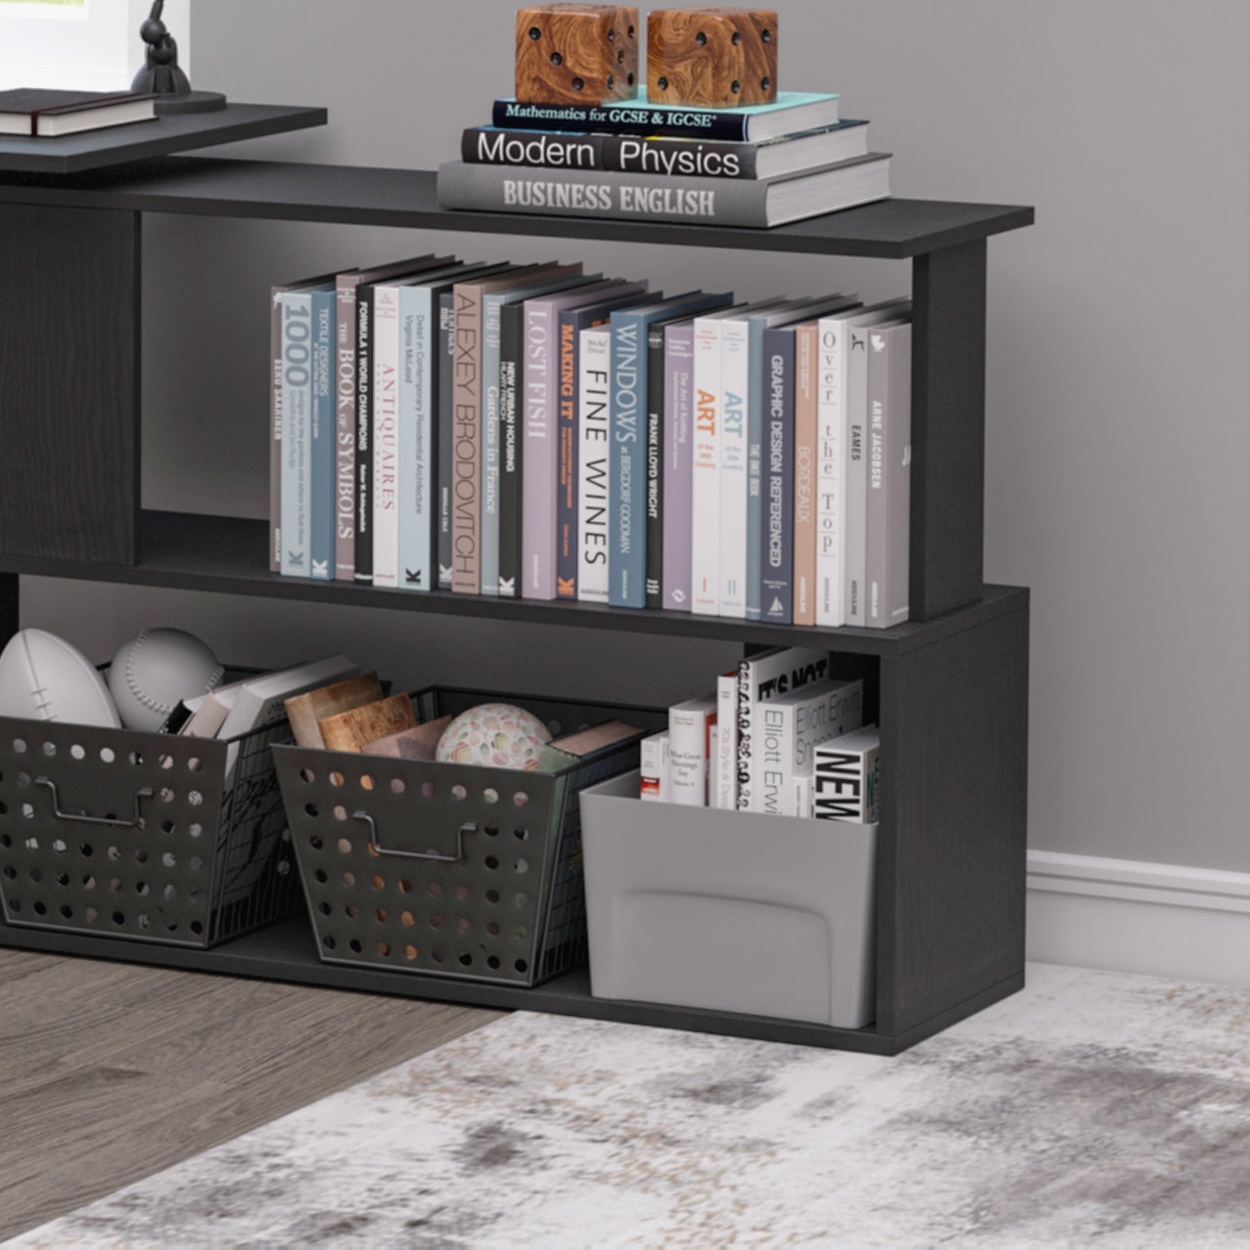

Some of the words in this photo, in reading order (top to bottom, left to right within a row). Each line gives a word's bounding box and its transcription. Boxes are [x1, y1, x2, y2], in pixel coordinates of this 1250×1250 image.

[506, 103, 586, 122] Mathematics
[589, 107, 607, 122] for
[609, 109, 648, 124] GCSE
[652, 111, 664, 125] &
[477, 132, 595, 166] Modern
[618, 141, 740, 176] Physics
[503, 180, 612, 210] BUSINESS
[619, 187, 715, 216] ENGLISH
[285, 304, 309, 387] 1000
[319, 308, 328, 343] TEXTILE
[339, 323, 347, 343] THE
[359, 302, 368, 348] FORMULA
[404, 315, 414, 346] Virginia
[416, 316, 424, 339] Detail
[456, 294, 476, 396] ALEXEY
[528, 310, 547, 376] LOST
[319, 346, 328, 396] DESIGNERS
[339, 349, 354, 408] BOOK
[359, 358, 368, 392] WORLD
[405, 349, 414, 383] McLeod
[414, 352, 424, 411] Contemporary
[506, 362, 515, 385] NEW
[561, 324, 573, 396] MAKING
[615, 323, 637, 442] WINDOWS
[680, 372, 688, 385] The
[506, 388, 515, 423] URBAN
[586, 369, 607, 442] FINE
[680, 387, 688, 400] Art
[680, 403, 688, 411] of
[770, 355, 783, 417] GRAPHIC
[339, 414, 347, 428] OF
[358, 394, 368, 450] CHAMPIONS
[487, 386, 498, 445] Gardens
[528, 382, 547, 438] FISH
[561, 401, 573, 419] IT
[648, 414, 658, 445] FRANK
[678, 412, 688, 444] Knitting
[697, 389, 716, 436] ART
[724, 391, 743, 438] ART
[872, 401, 882, 429] ARNE
[379, 364, 395, 510] ANTIQUAIRES
[415, 414, 424, 461] Residential
[487, 448, 498, 461] in
[506, 425, 515, 471] HOUSING
[750, 444, 760, 458] THE
[770, 421, 783, 472] DESIGN
[851, 425, 861, 461] EAMES
[620, 455, 630, 503] BERGDORF
[648, 447, 658, 478] LLOYD
[797, 446, 810, 522] BORDEAUX
[871, 433, 882, 489] JACOBSEN
[338, 433, 354, 538] SYMBOLS
[415, 464, 424, 514] Architecture
[455, 405, 476, 573] BRODOVITCH
[487, 467, 497, 513] France
[648, 480, 658, 518] WRIGHT
[585, 459, 606, 566] WINES
[620, 505, 630, 553] GOODMAN
[769, 476, 782, 567] REFERENCED
[765, 710, 783, 764] Elliott
[764, 771, 783, 814] Erwi
